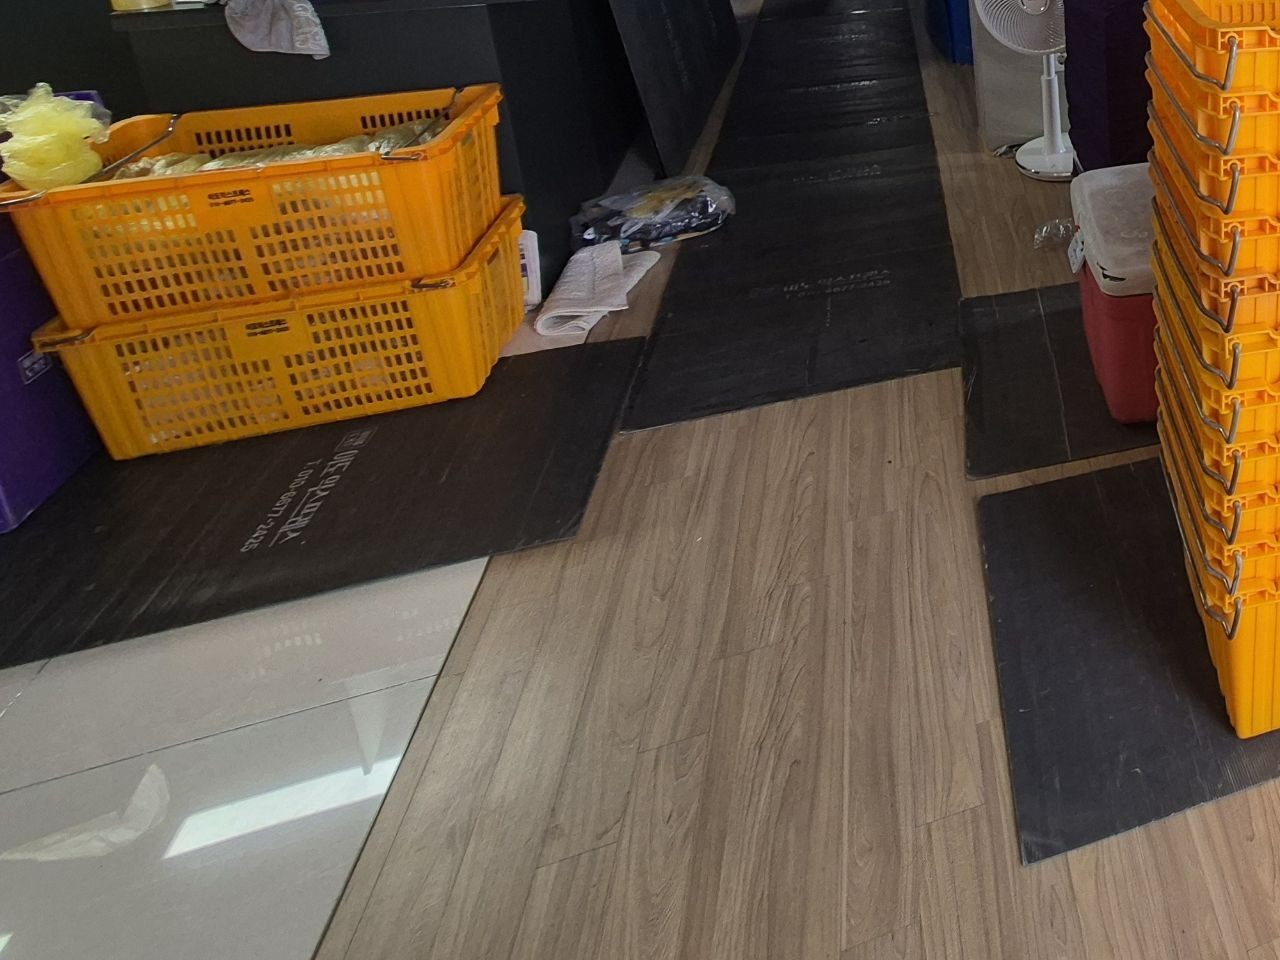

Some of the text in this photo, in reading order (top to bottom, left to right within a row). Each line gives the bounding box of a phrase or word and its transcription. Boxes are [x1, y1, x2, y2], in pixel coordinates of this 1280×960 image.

[320, 450, 359, 477] 이도
[240, 469, 314, 552] 010-6677-2425
[268, 475, 341, 547] 익스프레스
